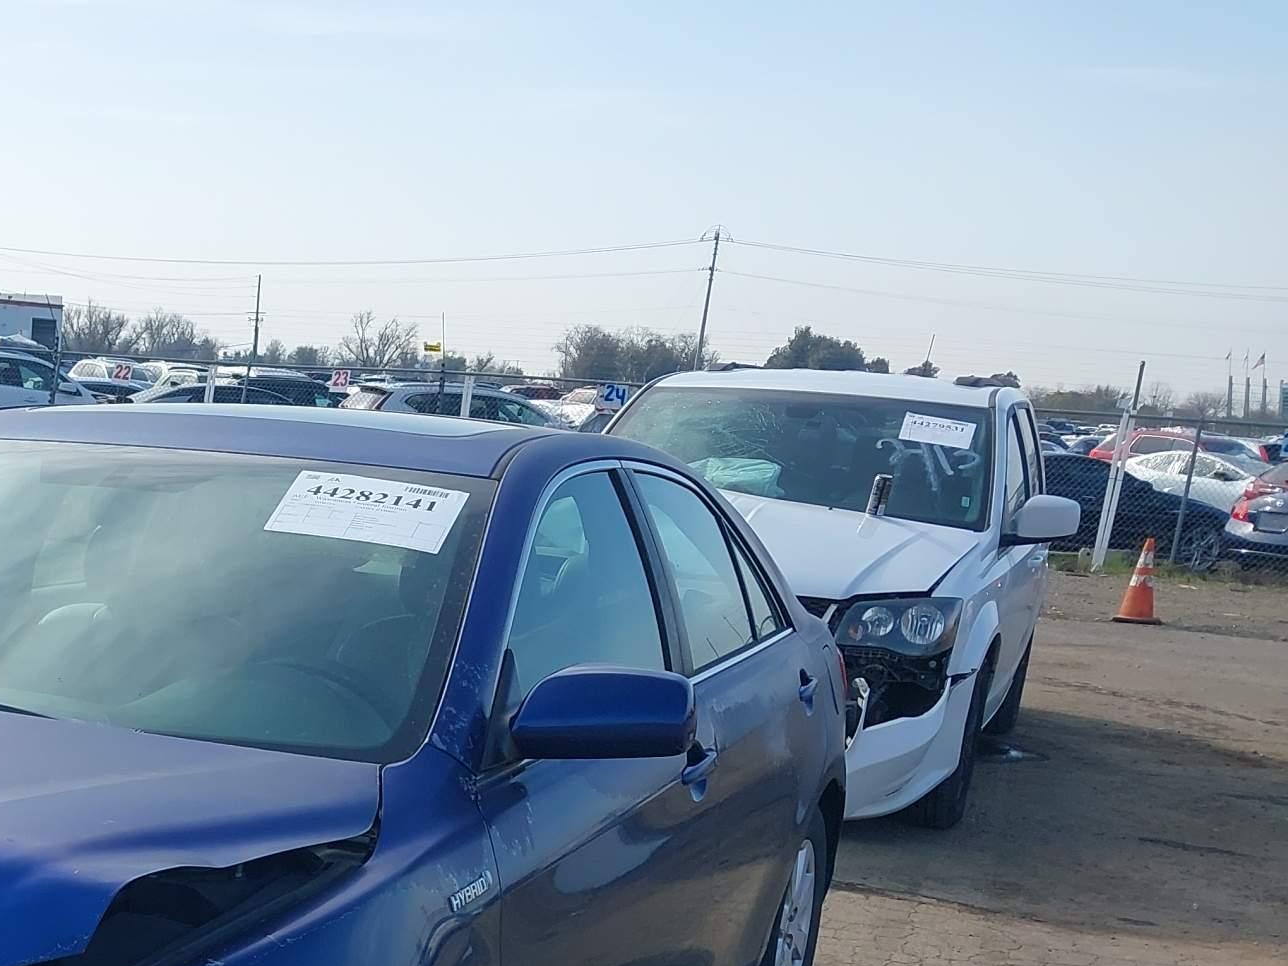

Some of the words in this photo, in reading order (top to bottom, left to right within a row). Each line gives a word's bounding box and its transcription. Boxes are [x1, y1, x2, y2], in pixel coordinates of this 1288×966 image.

[115, 365, 131, 381] 22
[332, 370, 348, 386] 23
[604, 384, 626, 406] 24
[307, 484, 439, 512] 44282141
[450, 877, 489, 912] HYBRID
